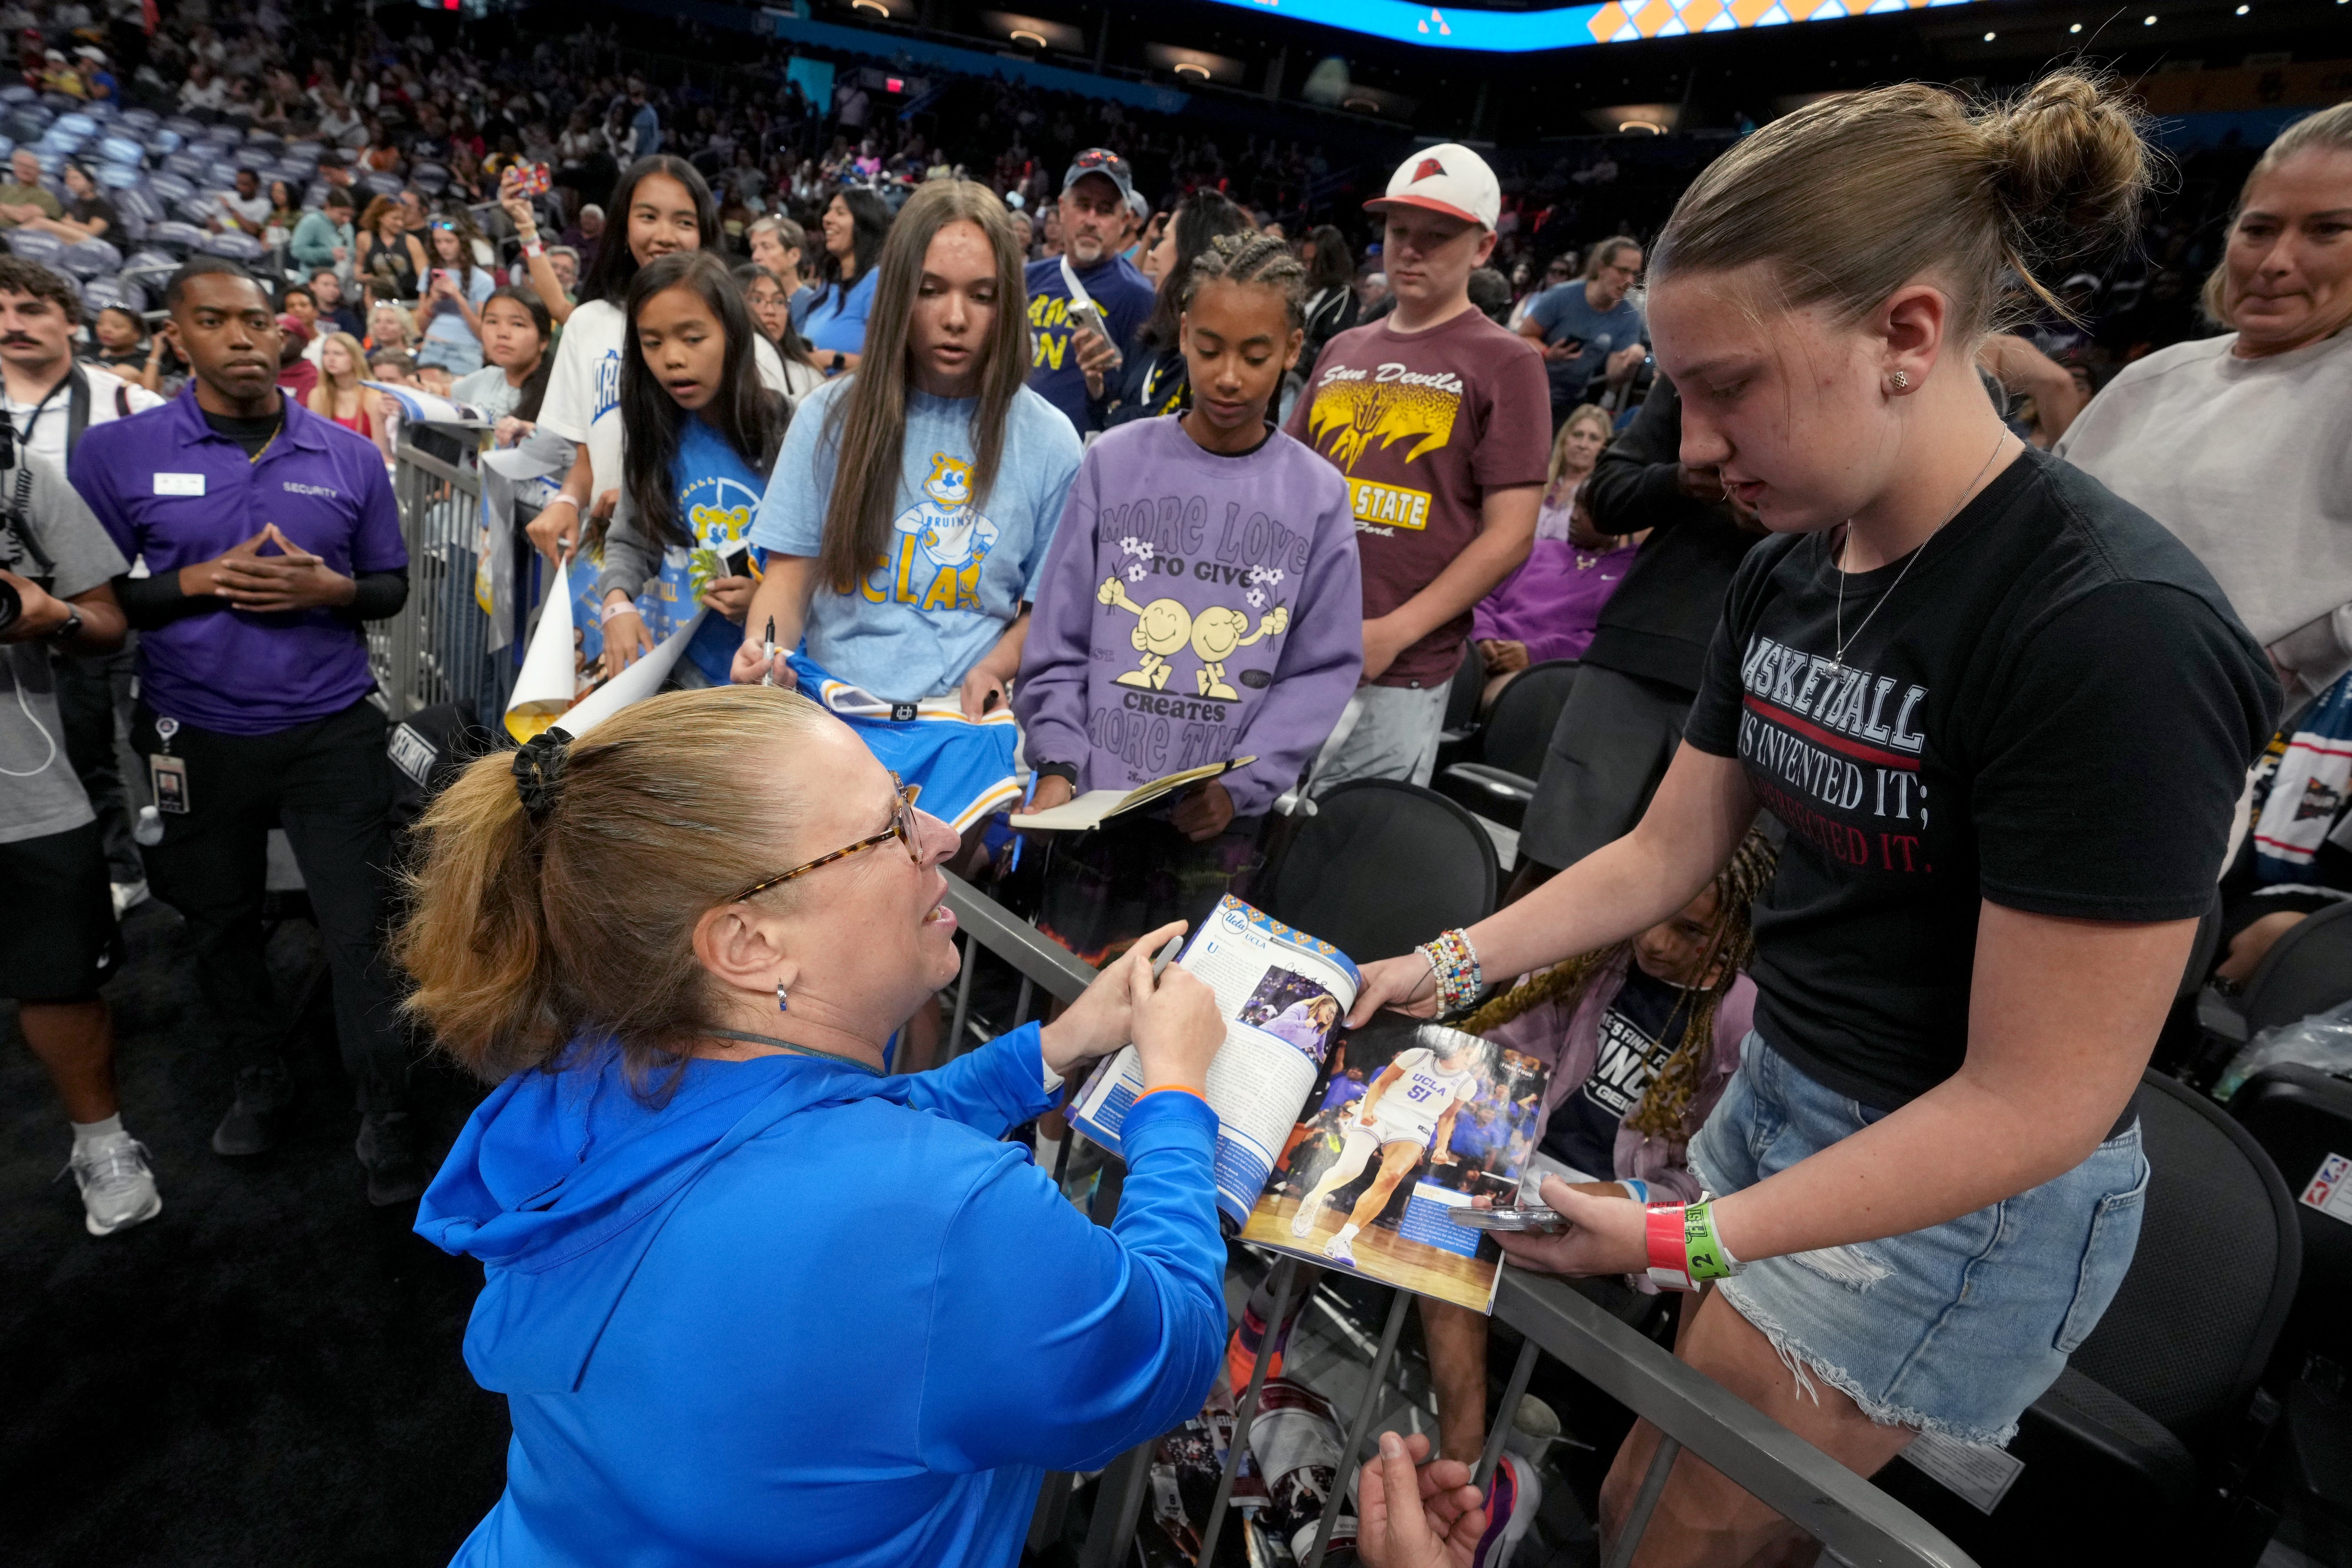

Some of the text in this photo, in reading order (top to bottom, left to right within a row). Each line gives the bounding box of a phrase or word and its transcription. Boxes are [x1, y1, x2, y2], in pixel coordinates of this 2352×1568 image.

[1318, 362, 1463, 394] Sun Devils
[283, 481, 338, 498] SECURITY
[1355, 485, 1427, 526] STATE
[926, 515, 972, 528] BRUINS
[1151, 554, 1185, 577] TO
[1756, 723, 1863, 810] INVENTED
[1874, 769, 1928, 830] IT;
[1880, 833, 1932, 873] IT.
[1225, 912, 1245, 930] Ucla
[1245, 933, 1266, 949] UCLA
[1620, 1028, 1652, 1059] FINA
[1501, 1061, 1534, 1078] FINAL FOUR
[1407, 1084, 1432, 1103] 51
[1412, 1073, 1446, 1097] UCLA
[1228, 1168, 1239, 1176] Bench
[1415, 1190, 1433, 1198] BETTS
[1417, 1185, 1440, 1195] LAUREN
[1687, 1210, 1704, 1234] FEST
